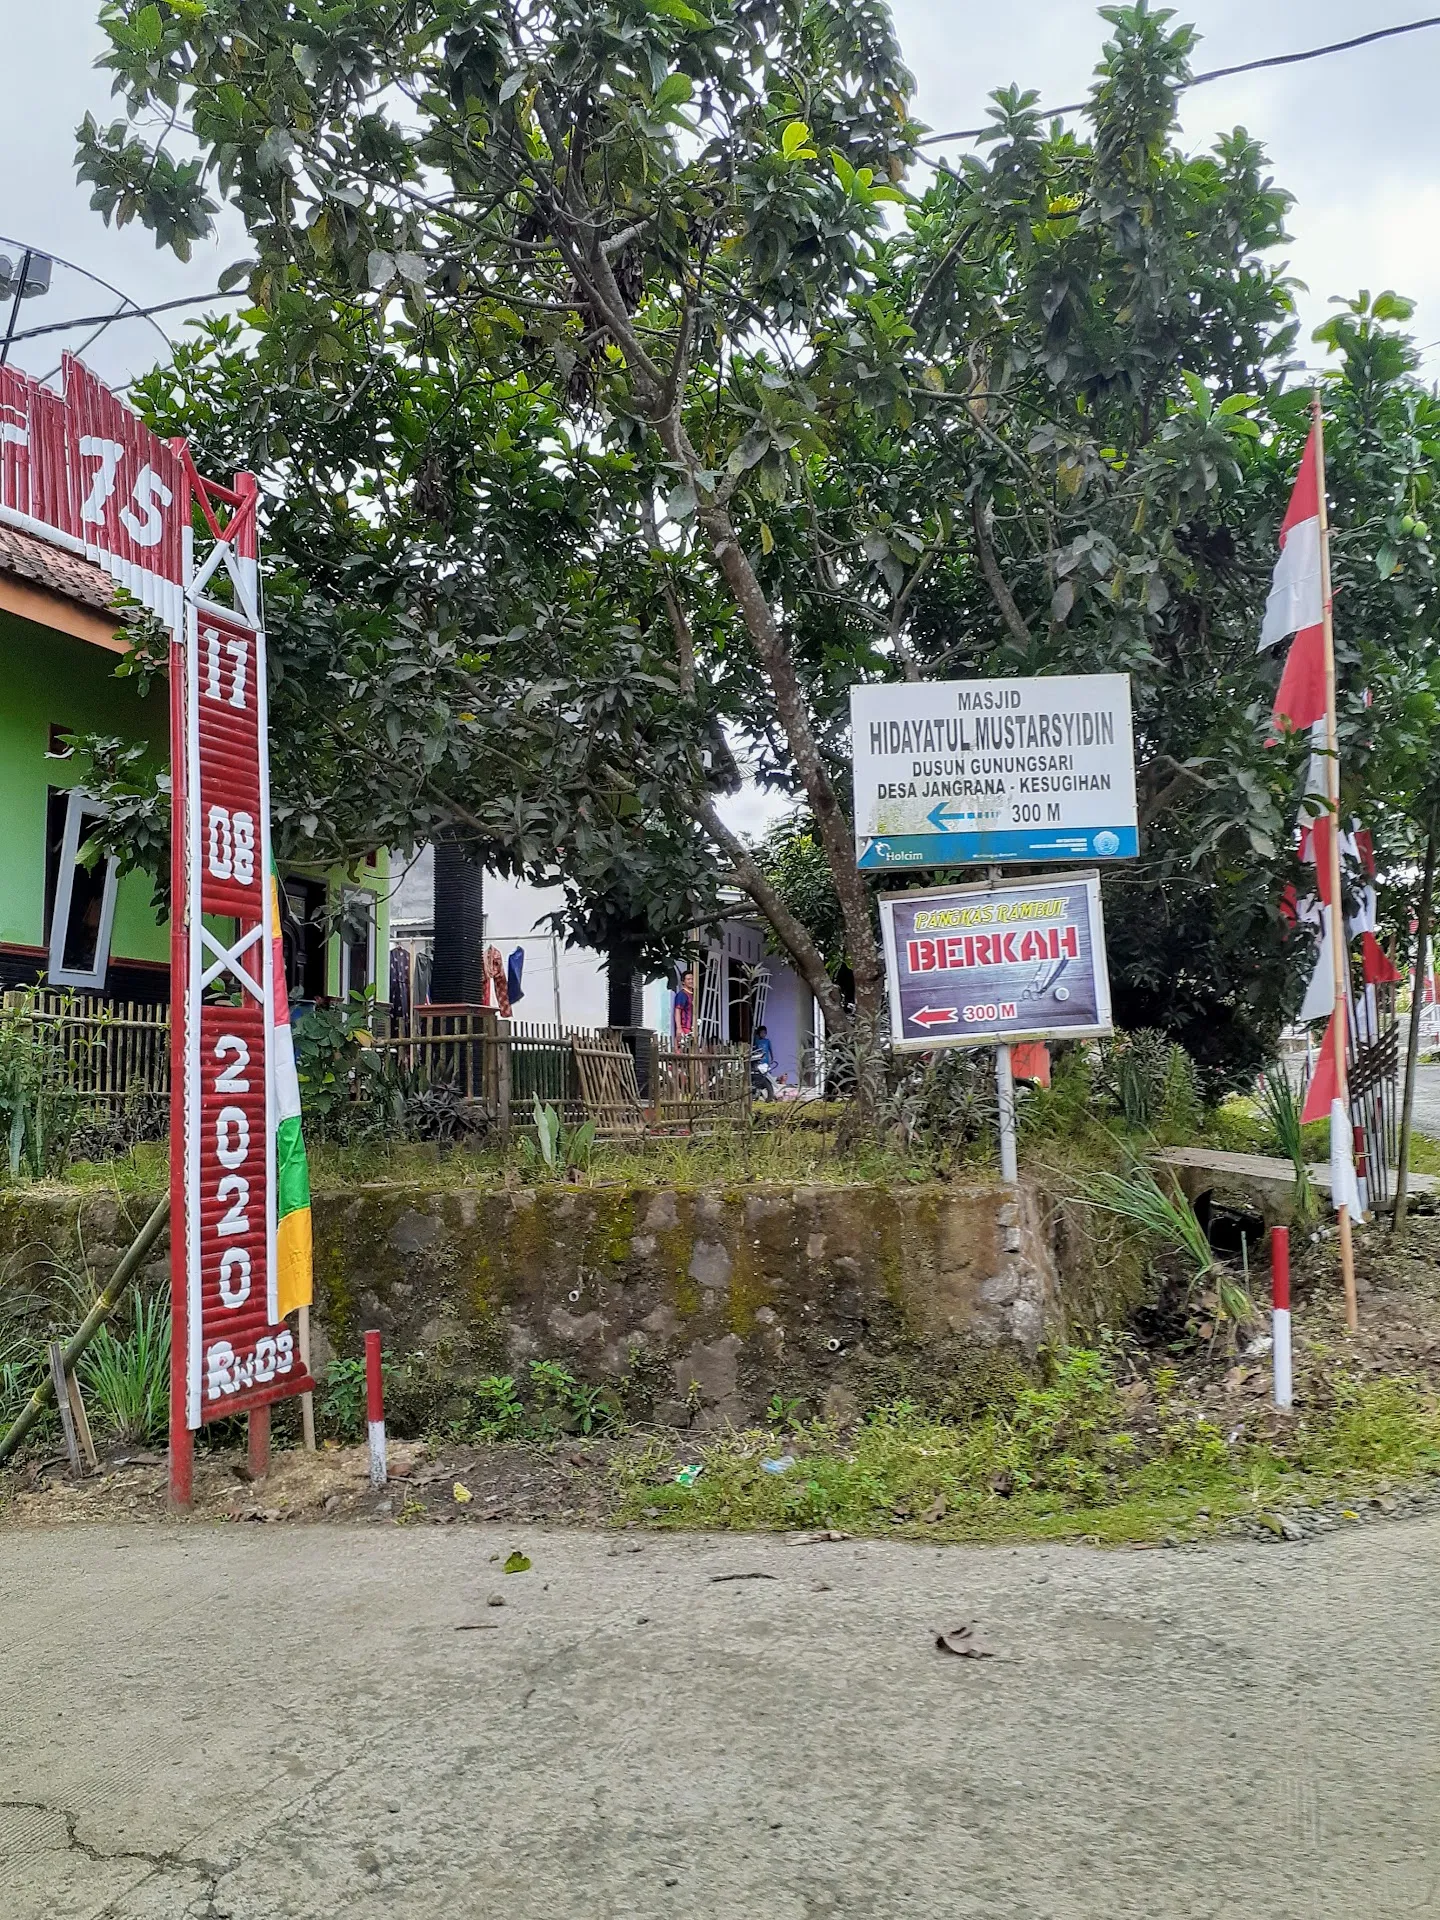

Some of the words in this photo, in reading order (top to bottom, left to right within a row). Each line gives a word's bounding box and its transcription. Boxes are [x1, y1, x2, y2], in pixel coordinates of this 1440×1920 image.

[79, 435, 173, 547] 75
[203, 628, 248, 709] 17
[958, 690, 1021, 711] MASJID
[869, 718, 970, 755] HIDAYATUL
[975, 711, 1115, 751] MUSTARSYIDIN
[912, 758, 965, 777] DUSUN
[970, 754, 1074, 774] GUNUNGSARI
[877, 782, 917, 800] DESA
[921, 778, 1006, 798] JANGRANA
[1019, 774, 1111, 794] KESUGIHAN
[1012, 803, 1042, 823] 300
[1047, 803, 1060, 822] M
[208, 805, 254, 886] 08
[886, 851, 923, 862] Holcim
[915, 905, 994, 930] PANGKAS
[996, 899, 1067, 924] RAMBUT
[908, 926, 1078, 972] BERKAH
[964, 1004, 995, 1021] 300
[1001, 1003, 1016, 1018] M
